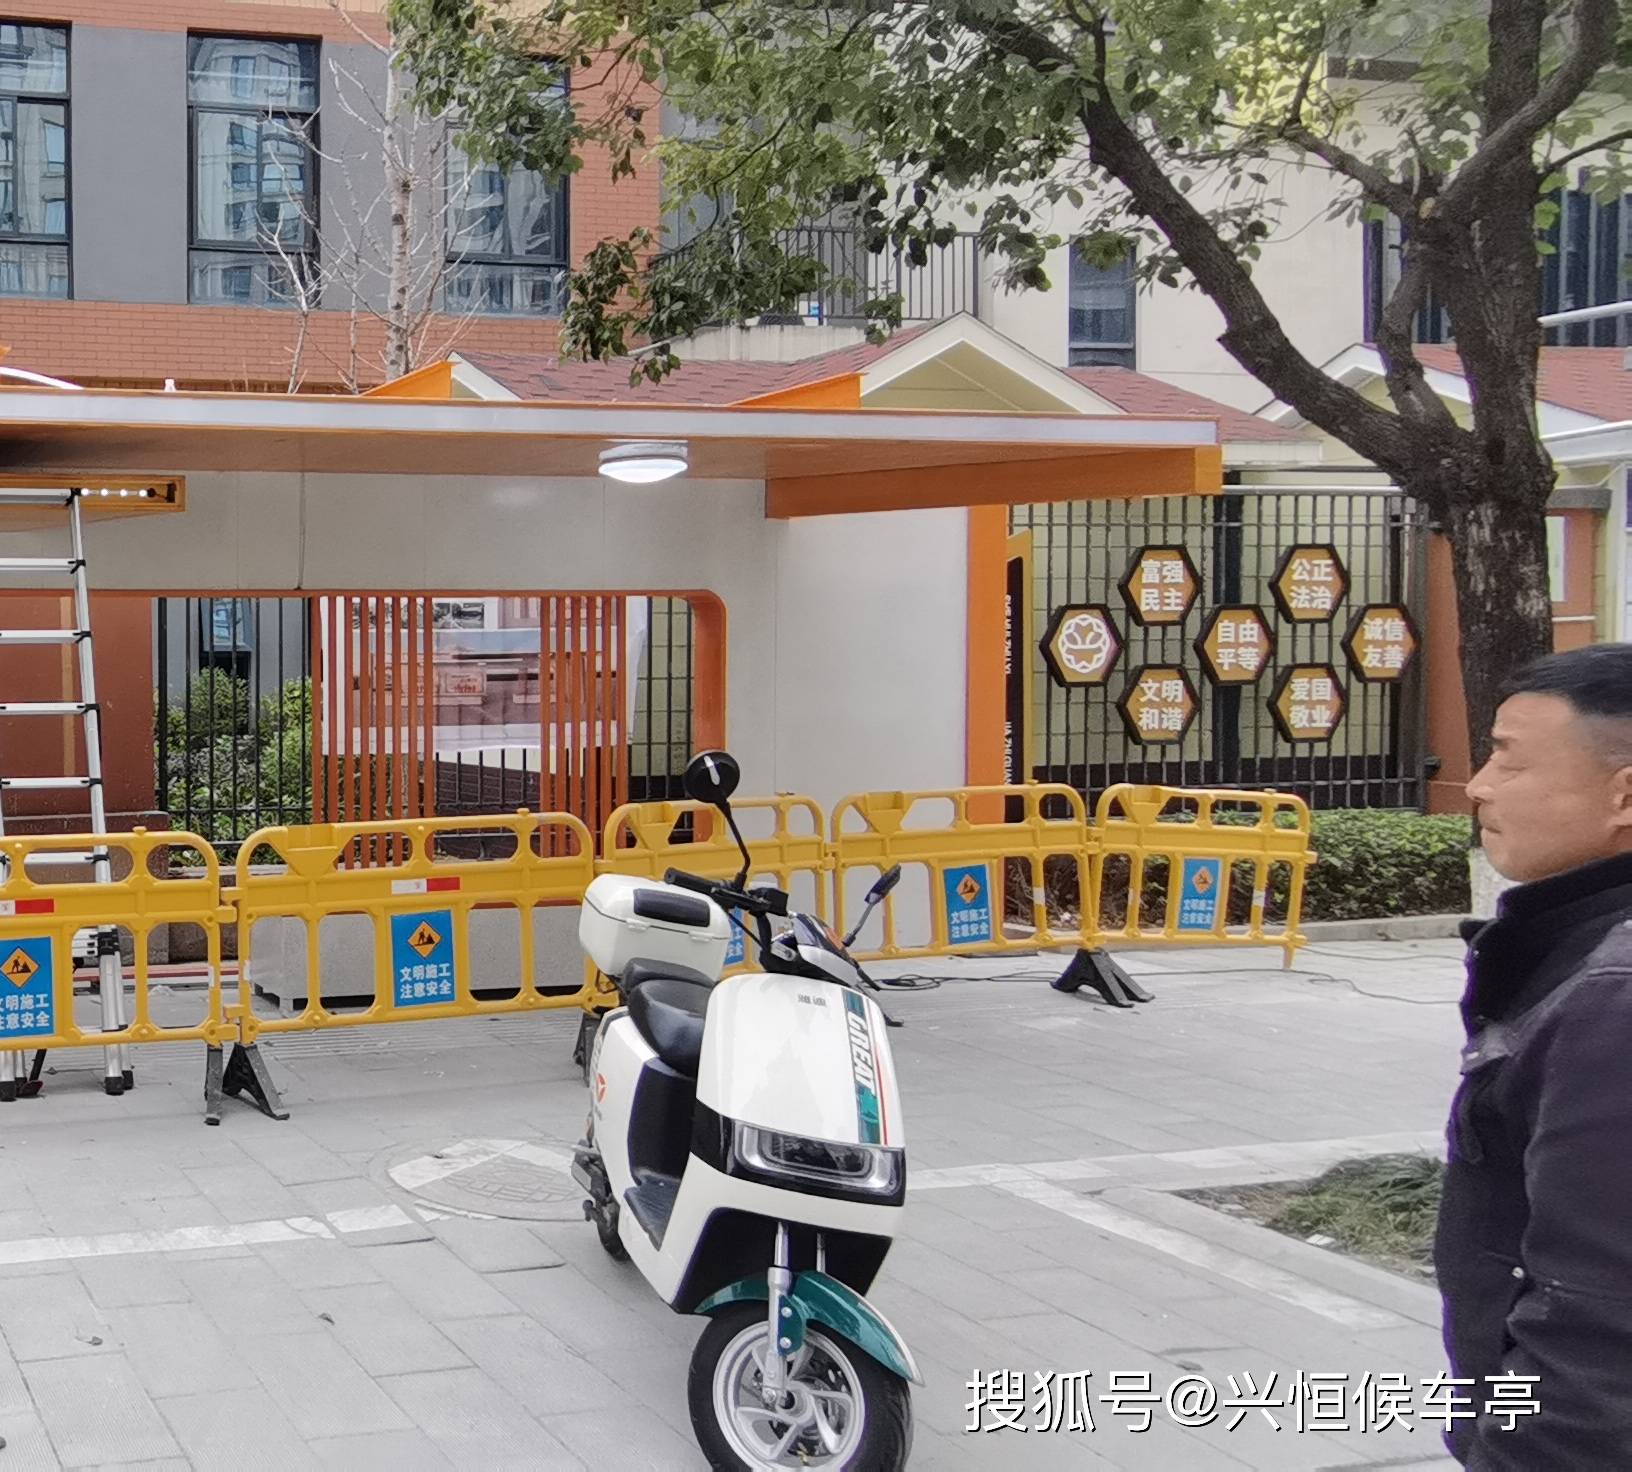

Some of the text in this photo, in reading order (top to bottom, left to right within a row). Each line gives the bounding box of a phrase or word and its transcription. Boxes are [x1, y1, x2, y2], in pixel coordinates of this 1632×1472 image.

[1141, 559, 1184, 584] 富强
[1290, 558, 1333, 582] 公正
[1140, 588, 1184, 611] 民主
[1290, 586, 1332, 609] 法治
[1218, 619, 1259, 643] 自由
[1363, 618, 1405, 641] 诚信
[1216, 647, 1260, 671] 平等
[1363, 645, 1405, 669] 友善
[1139, 679, 1184, 702] 文明
[1290, 678, 1332, 700] 爱国
[1138, 707, 1184, 731] 和谐
[1289, 705, 1332, 728] 敬业
[400, 963, 451, 982] 文明施工
[400, 979, 452, 999] 注意安全
[848, 1011, 876, 1096] GREAT
